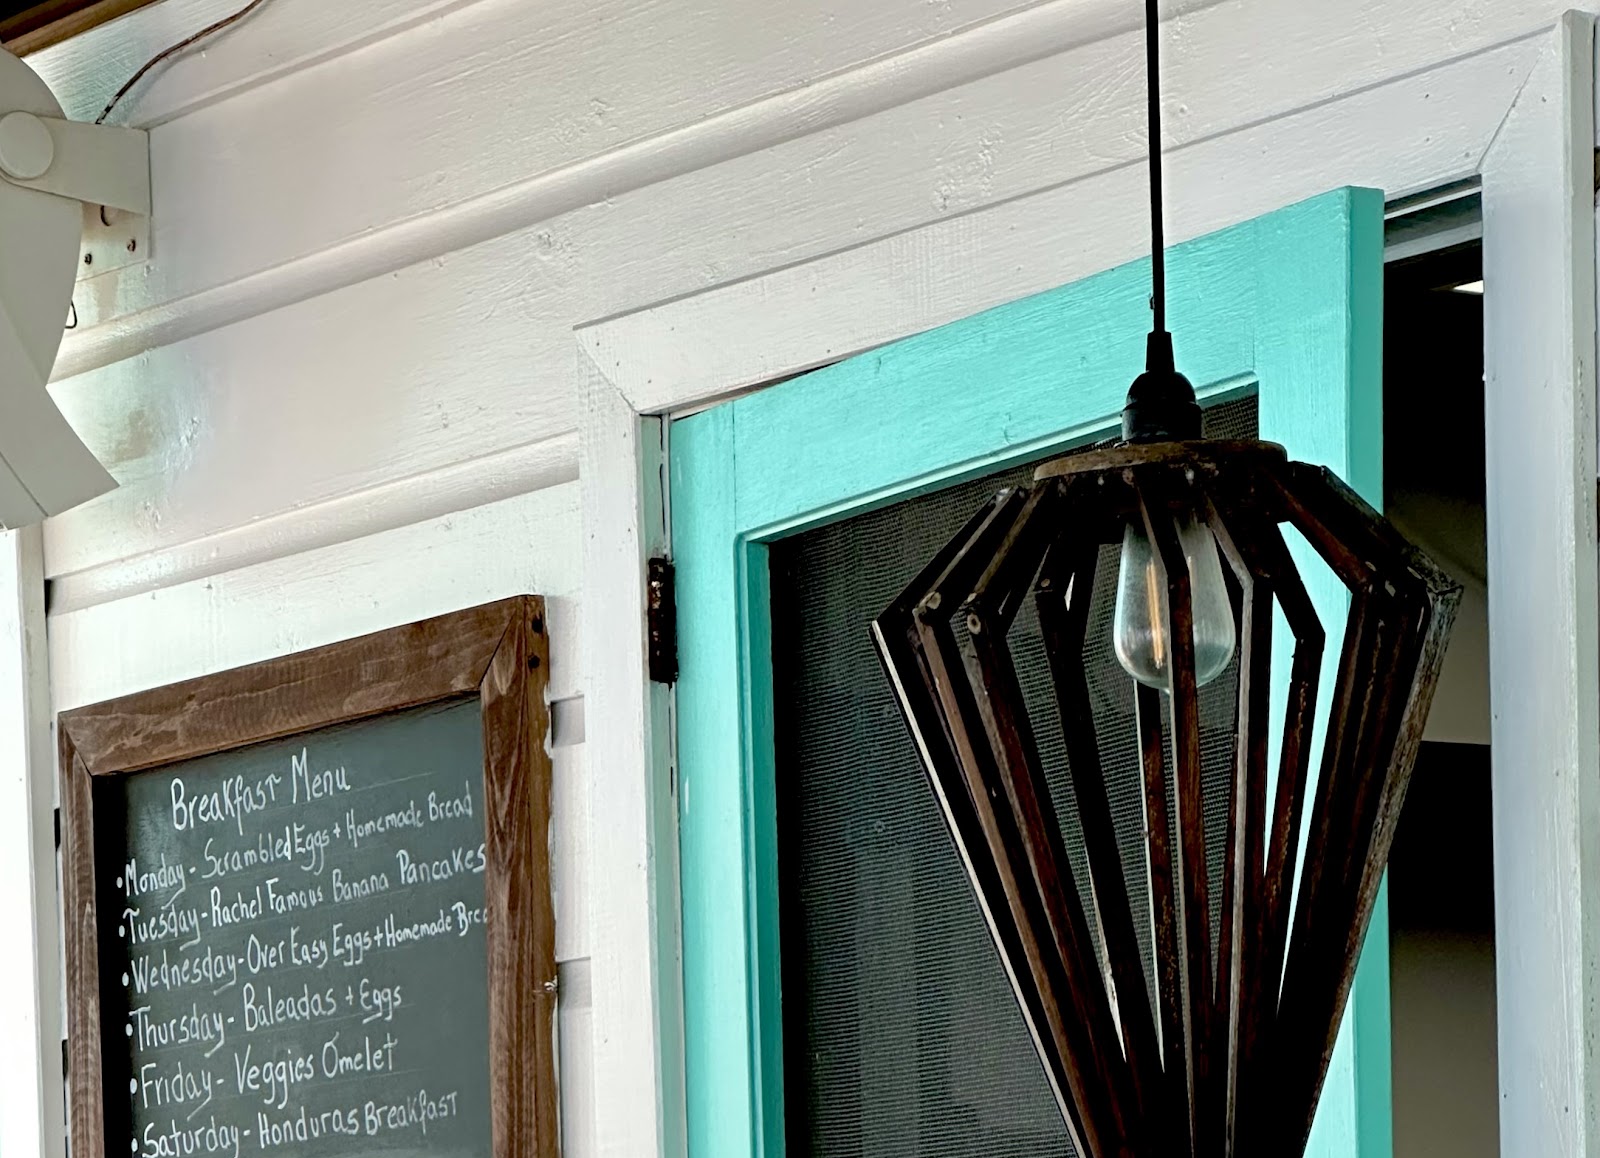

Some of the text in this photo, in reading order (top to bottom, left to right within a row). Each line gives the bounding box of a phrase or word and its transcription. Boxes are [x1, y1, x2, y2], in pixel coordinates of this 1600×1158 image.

[292, 747, 351, 803] Menu
[202, 836, 292, 879] Scrambled
[294, 821, 330, 875] Eggs
[346, 800, 423, 848] Homemade
[428, 780, 473, 818] Bread
[266, 877, 323, 911] Famous
[332, 869, 389, 903] Banana
[290, 926, 328, 969] Easy
[332, 922, 372, 967] Eggs
[384, 909, 452, 948] Homemade
[243, 983, 337, 1033] Baleadas
[361, 978, 402, 1024] Eggs
[234, 1044, 314, 1109] Veggies
[322, 1032, 397, 1078] Omelet
[257, 1105, 359, 1149] Honduras
